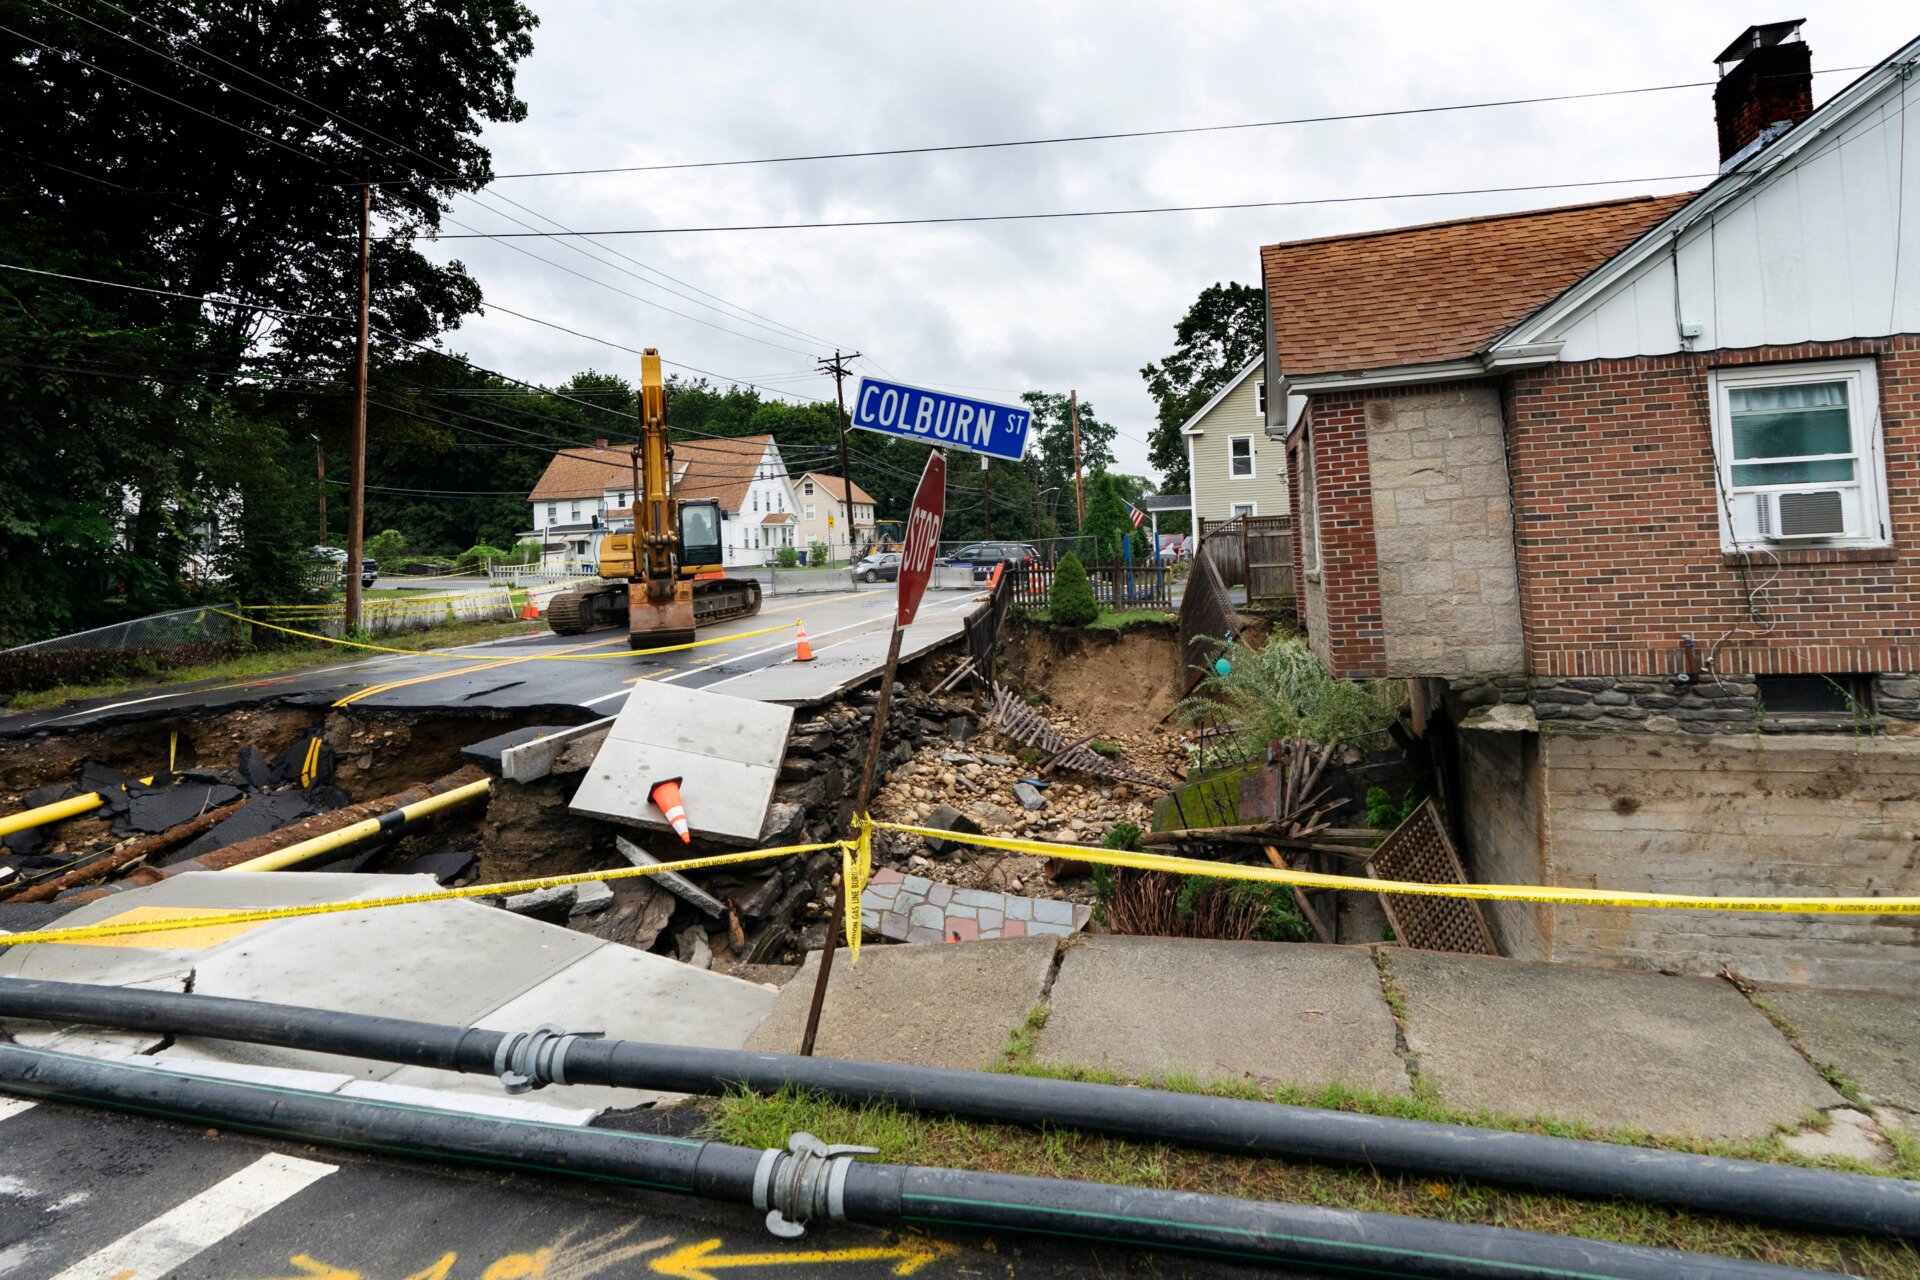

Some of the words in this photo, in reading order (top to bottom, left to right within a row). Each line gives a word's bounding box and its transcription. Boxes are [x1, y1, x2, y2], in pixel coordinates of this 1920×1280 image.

[860, 385, 996, 447] COLBURN
[1005, 413, 1025, 435] ST
[903, 506, 940, 573] STOP
[851, 890, 860, 904] LINE
[1699, 901, 1712, 909] GAS
[1730, 902, 1757, 910] BURIED
[1834, 904, 1867, 912] CAUTION
[1867, 904, 1882, 912] GAS
[1884, 904, 1900, 912] LINE
[851, 906, 860, 920] GAS
